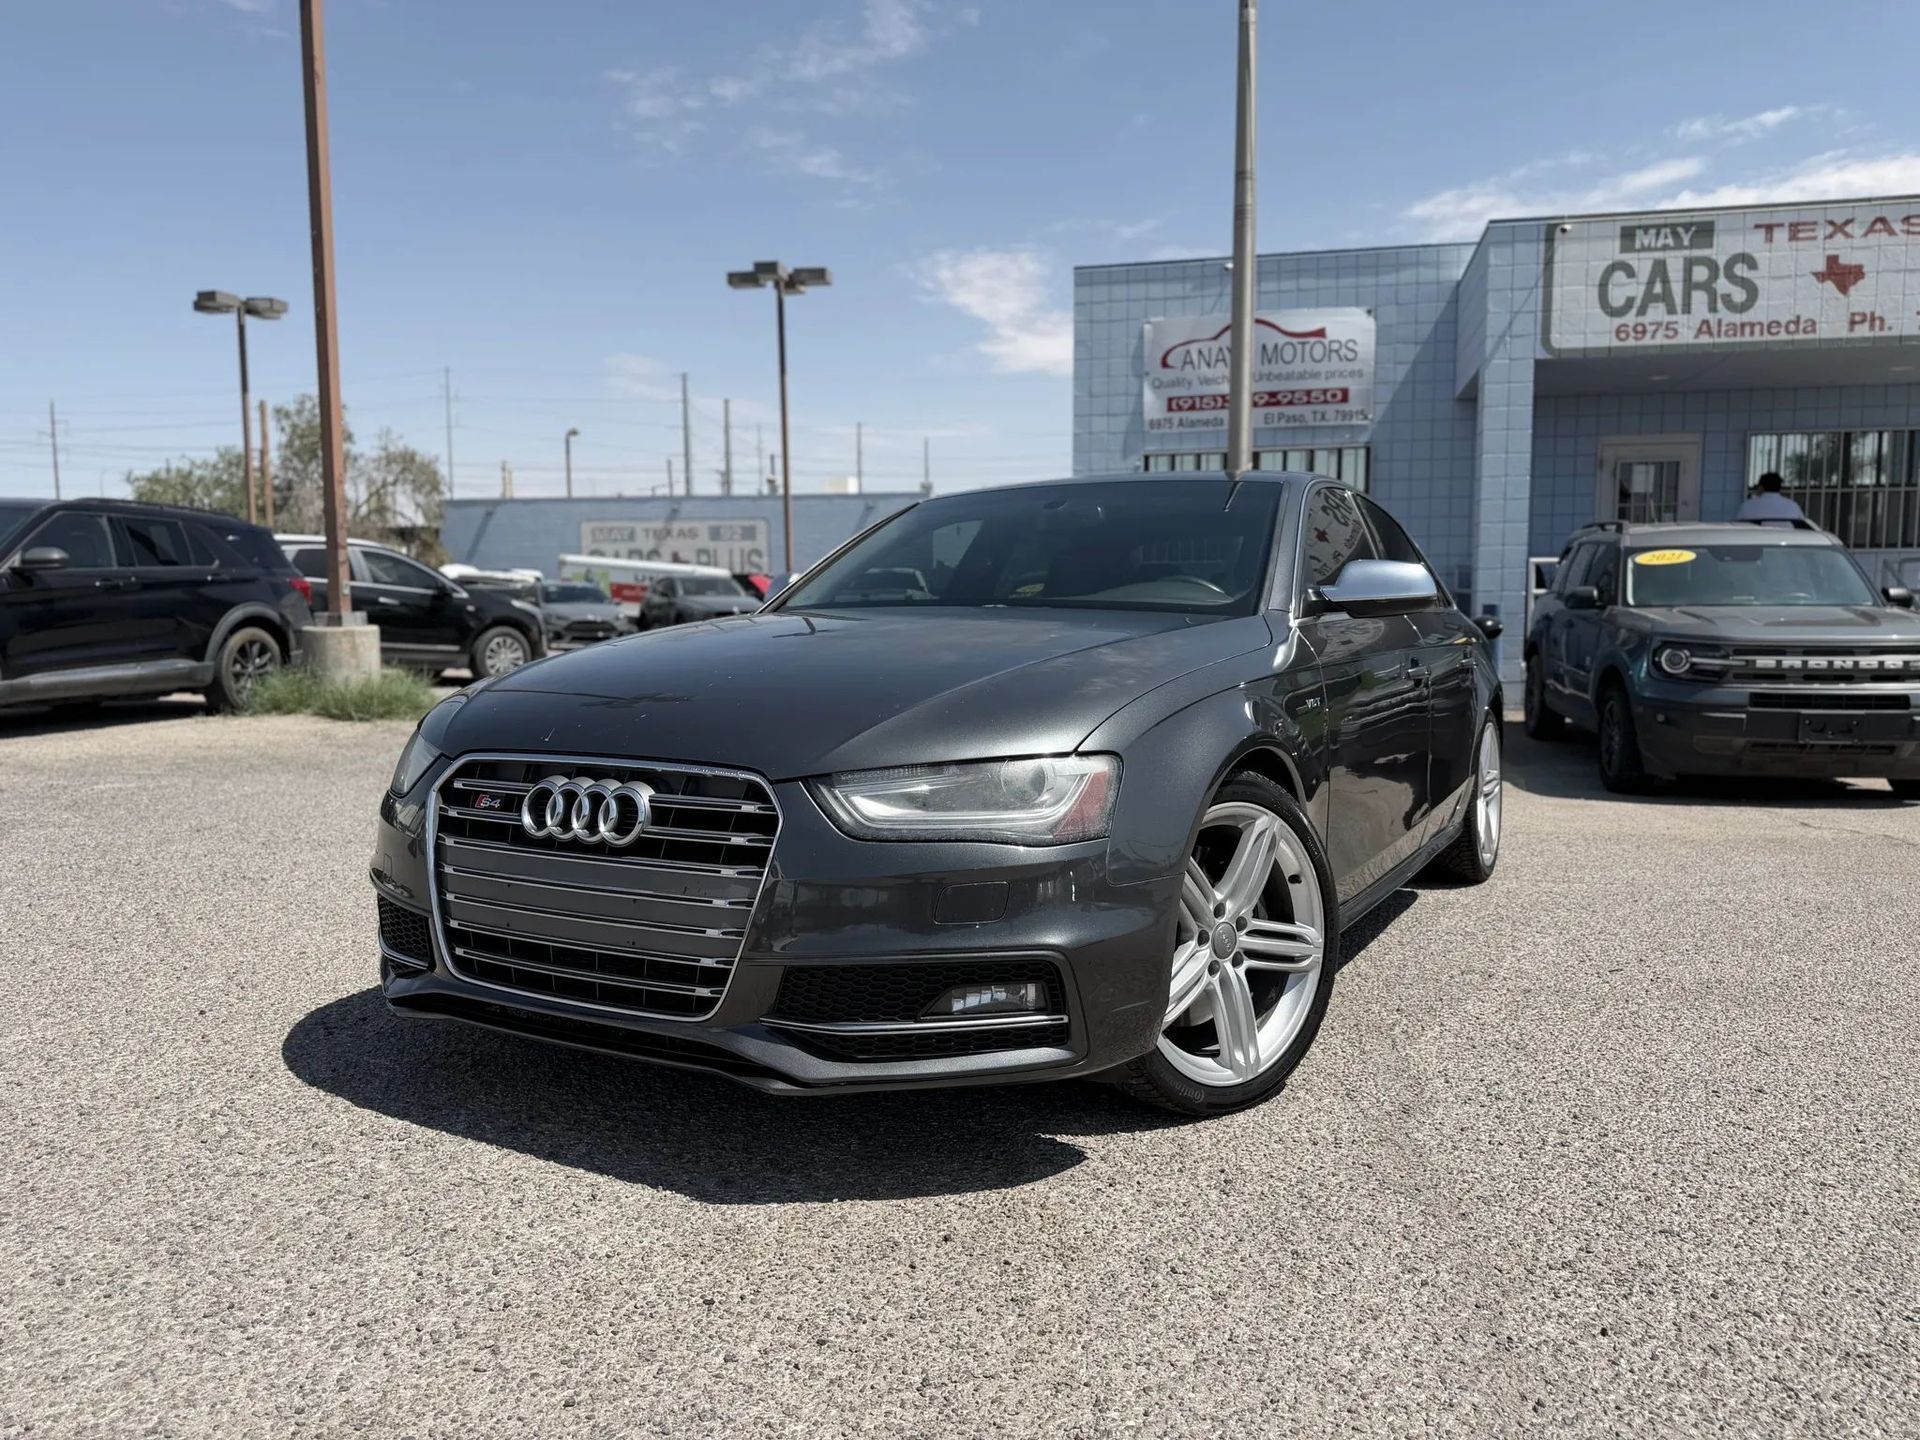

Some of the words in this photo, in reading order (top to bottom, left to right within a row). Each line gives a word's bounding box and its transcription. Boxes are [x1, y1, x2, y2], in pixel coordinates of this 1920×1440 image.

[1634, 226, 1697, 250] MAY
[1754, 214, 1920, 244] TEXAS
[1598, 252, 1759, 318] CARS
[1615, 321, 1679, 342] 6975
[1694, 315, 1817, 339] Alameda
[1849, 311, 1893, 333] Ph.
[1181, 346, 1232, 371] ANA
[1261, 339, 1359, 366] MOTORS
[1152, 376, 1194, 391] Quality
[1325, 367, 1364, 381] prices
[1171, 389, 1343, 411] (915)9-9550
[1177, 415, 1225, 428] Alameda
[1264, 412, 1275, 425] El
